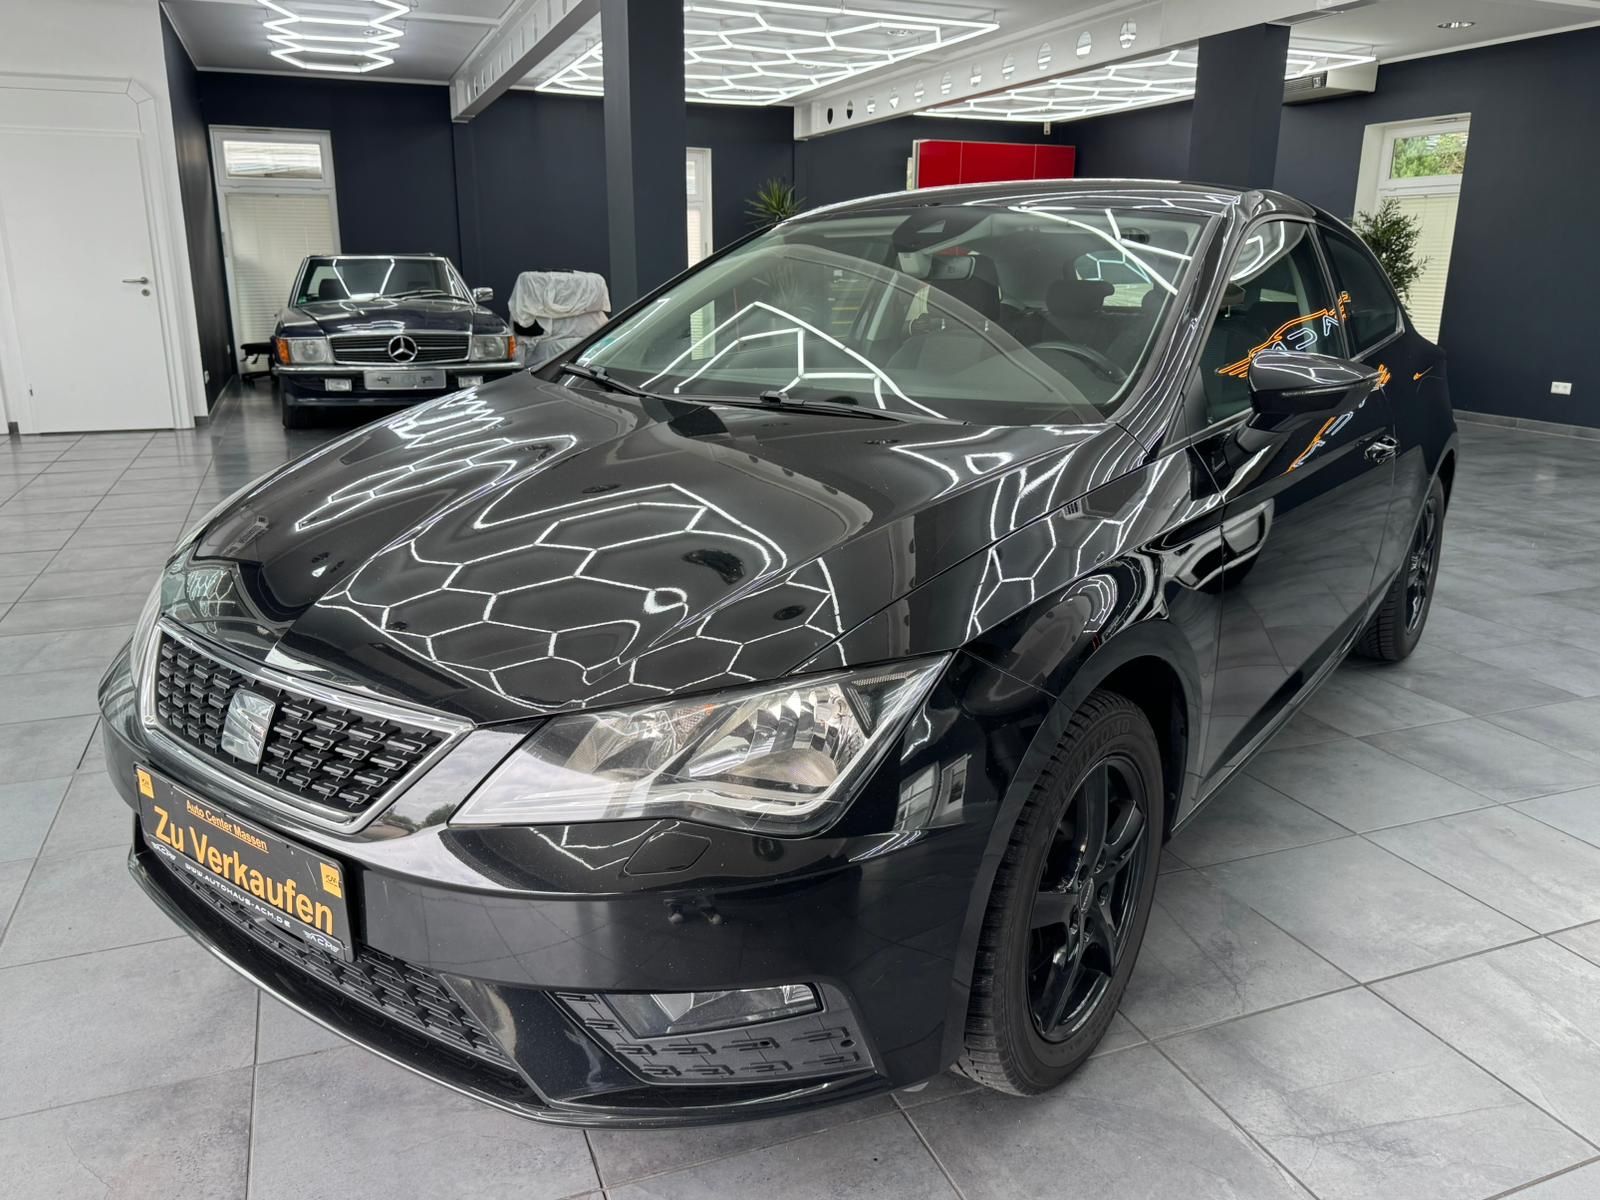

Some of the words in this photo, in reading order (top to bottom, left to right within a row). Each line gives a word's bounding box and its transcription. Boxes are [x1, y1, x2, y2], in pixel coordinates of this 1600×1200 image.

[154, 805, 185, 851] Zu
[189, 826, 333, 935] Verkaufen
[186, 799, 205, 817] Auto
[205, 809, 233, 832] Center
[233, 823, 268, 851] Massen
